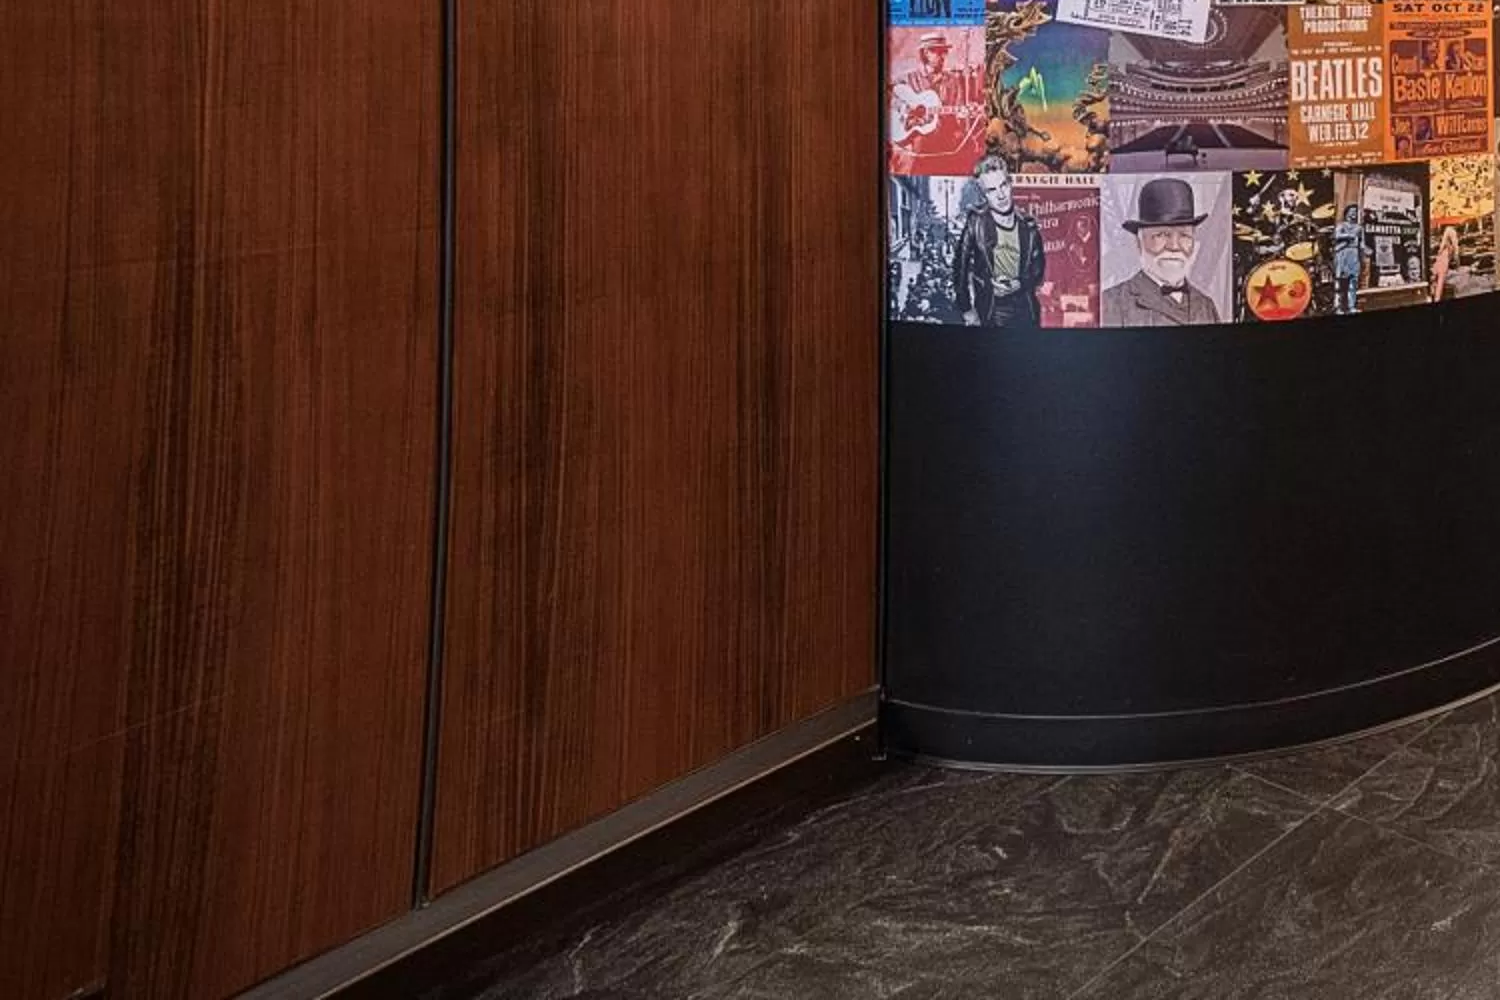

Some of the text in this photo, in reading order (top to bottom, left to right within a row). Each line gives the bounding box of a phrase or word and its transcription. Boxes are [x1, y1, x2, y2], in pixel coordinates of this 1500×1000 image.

[1392, 3, 1424, 12] SAT
[1432, 3, 1462, 12] OCT
[1291, 56, 1383, 101] BEATLES
[1393, 72, 1440, 102] Basie
